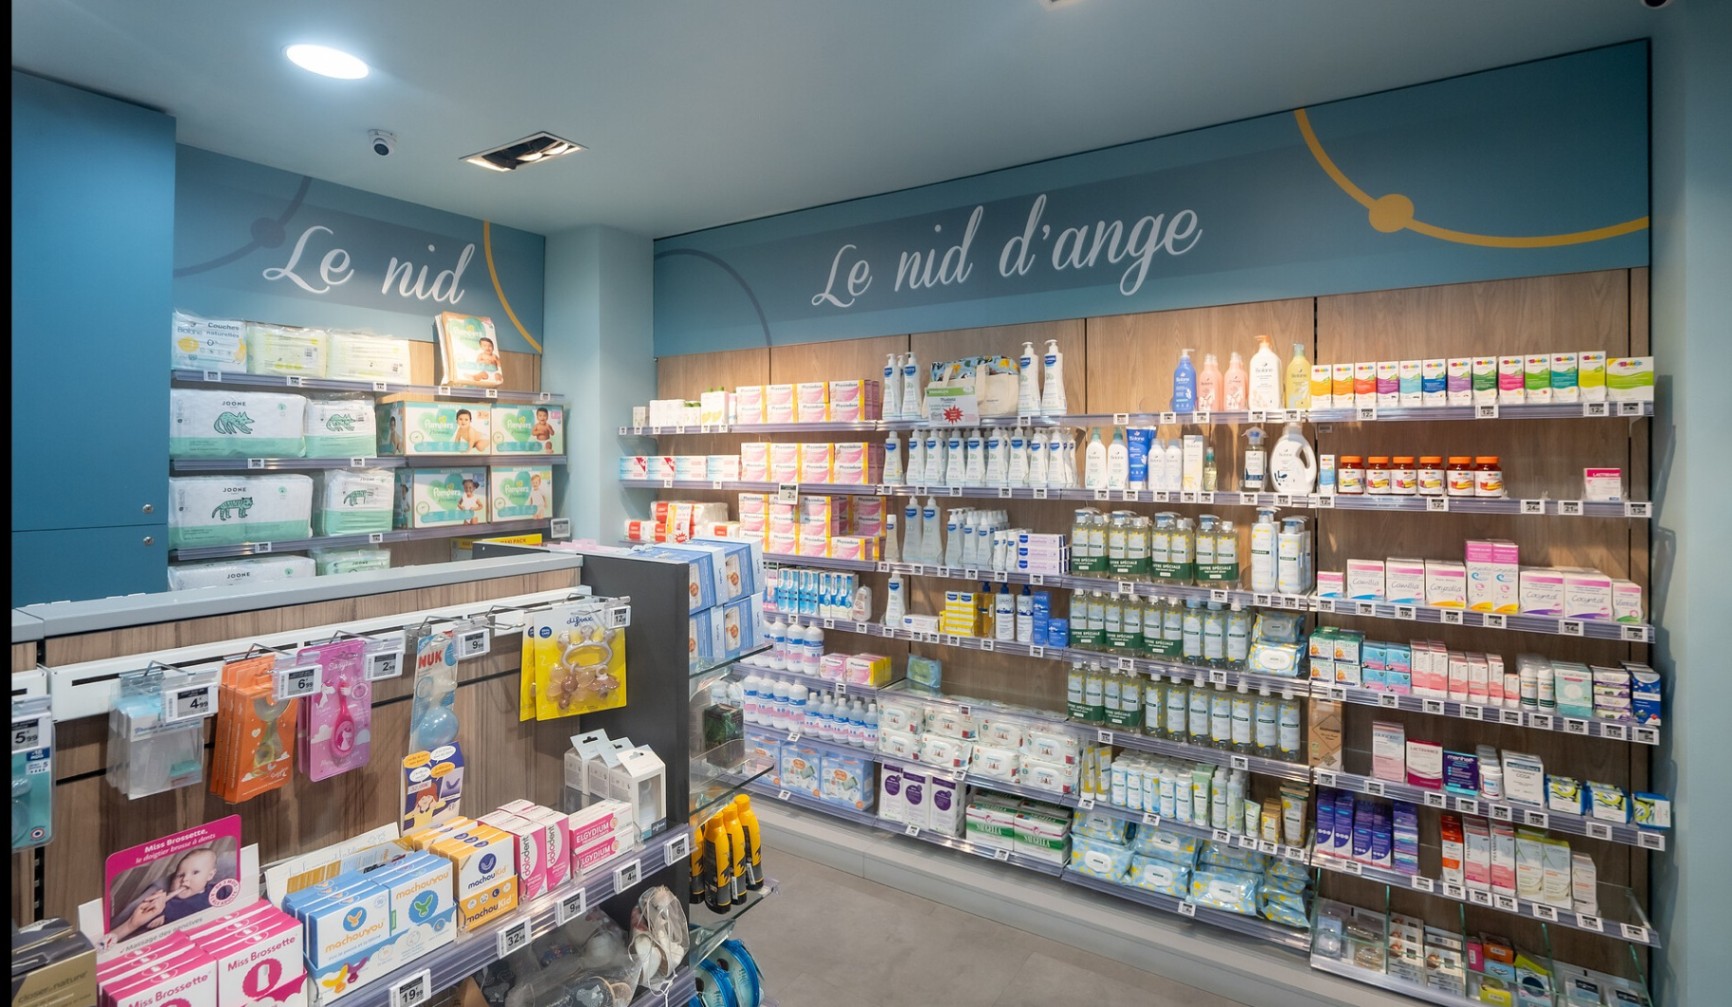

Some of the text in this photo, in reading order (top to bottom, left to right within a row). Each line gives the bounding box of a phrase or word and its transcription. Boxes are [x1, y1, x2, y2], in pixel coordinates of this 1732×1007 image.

[263, 226, 475, 304] Le nid
[811, 194, 1202, 307] Le nid d'ange
[418, 650, 442, 668] NUK
[144, 828, 208, 853] Miss Brossette.
[576, 822, 609, 843] ELGYDIUM
[521, 834, 530, 876] dolodent
[228, 936, 296, 972] Miss Brossette
[156, 974, 208, 1001] Brossette
